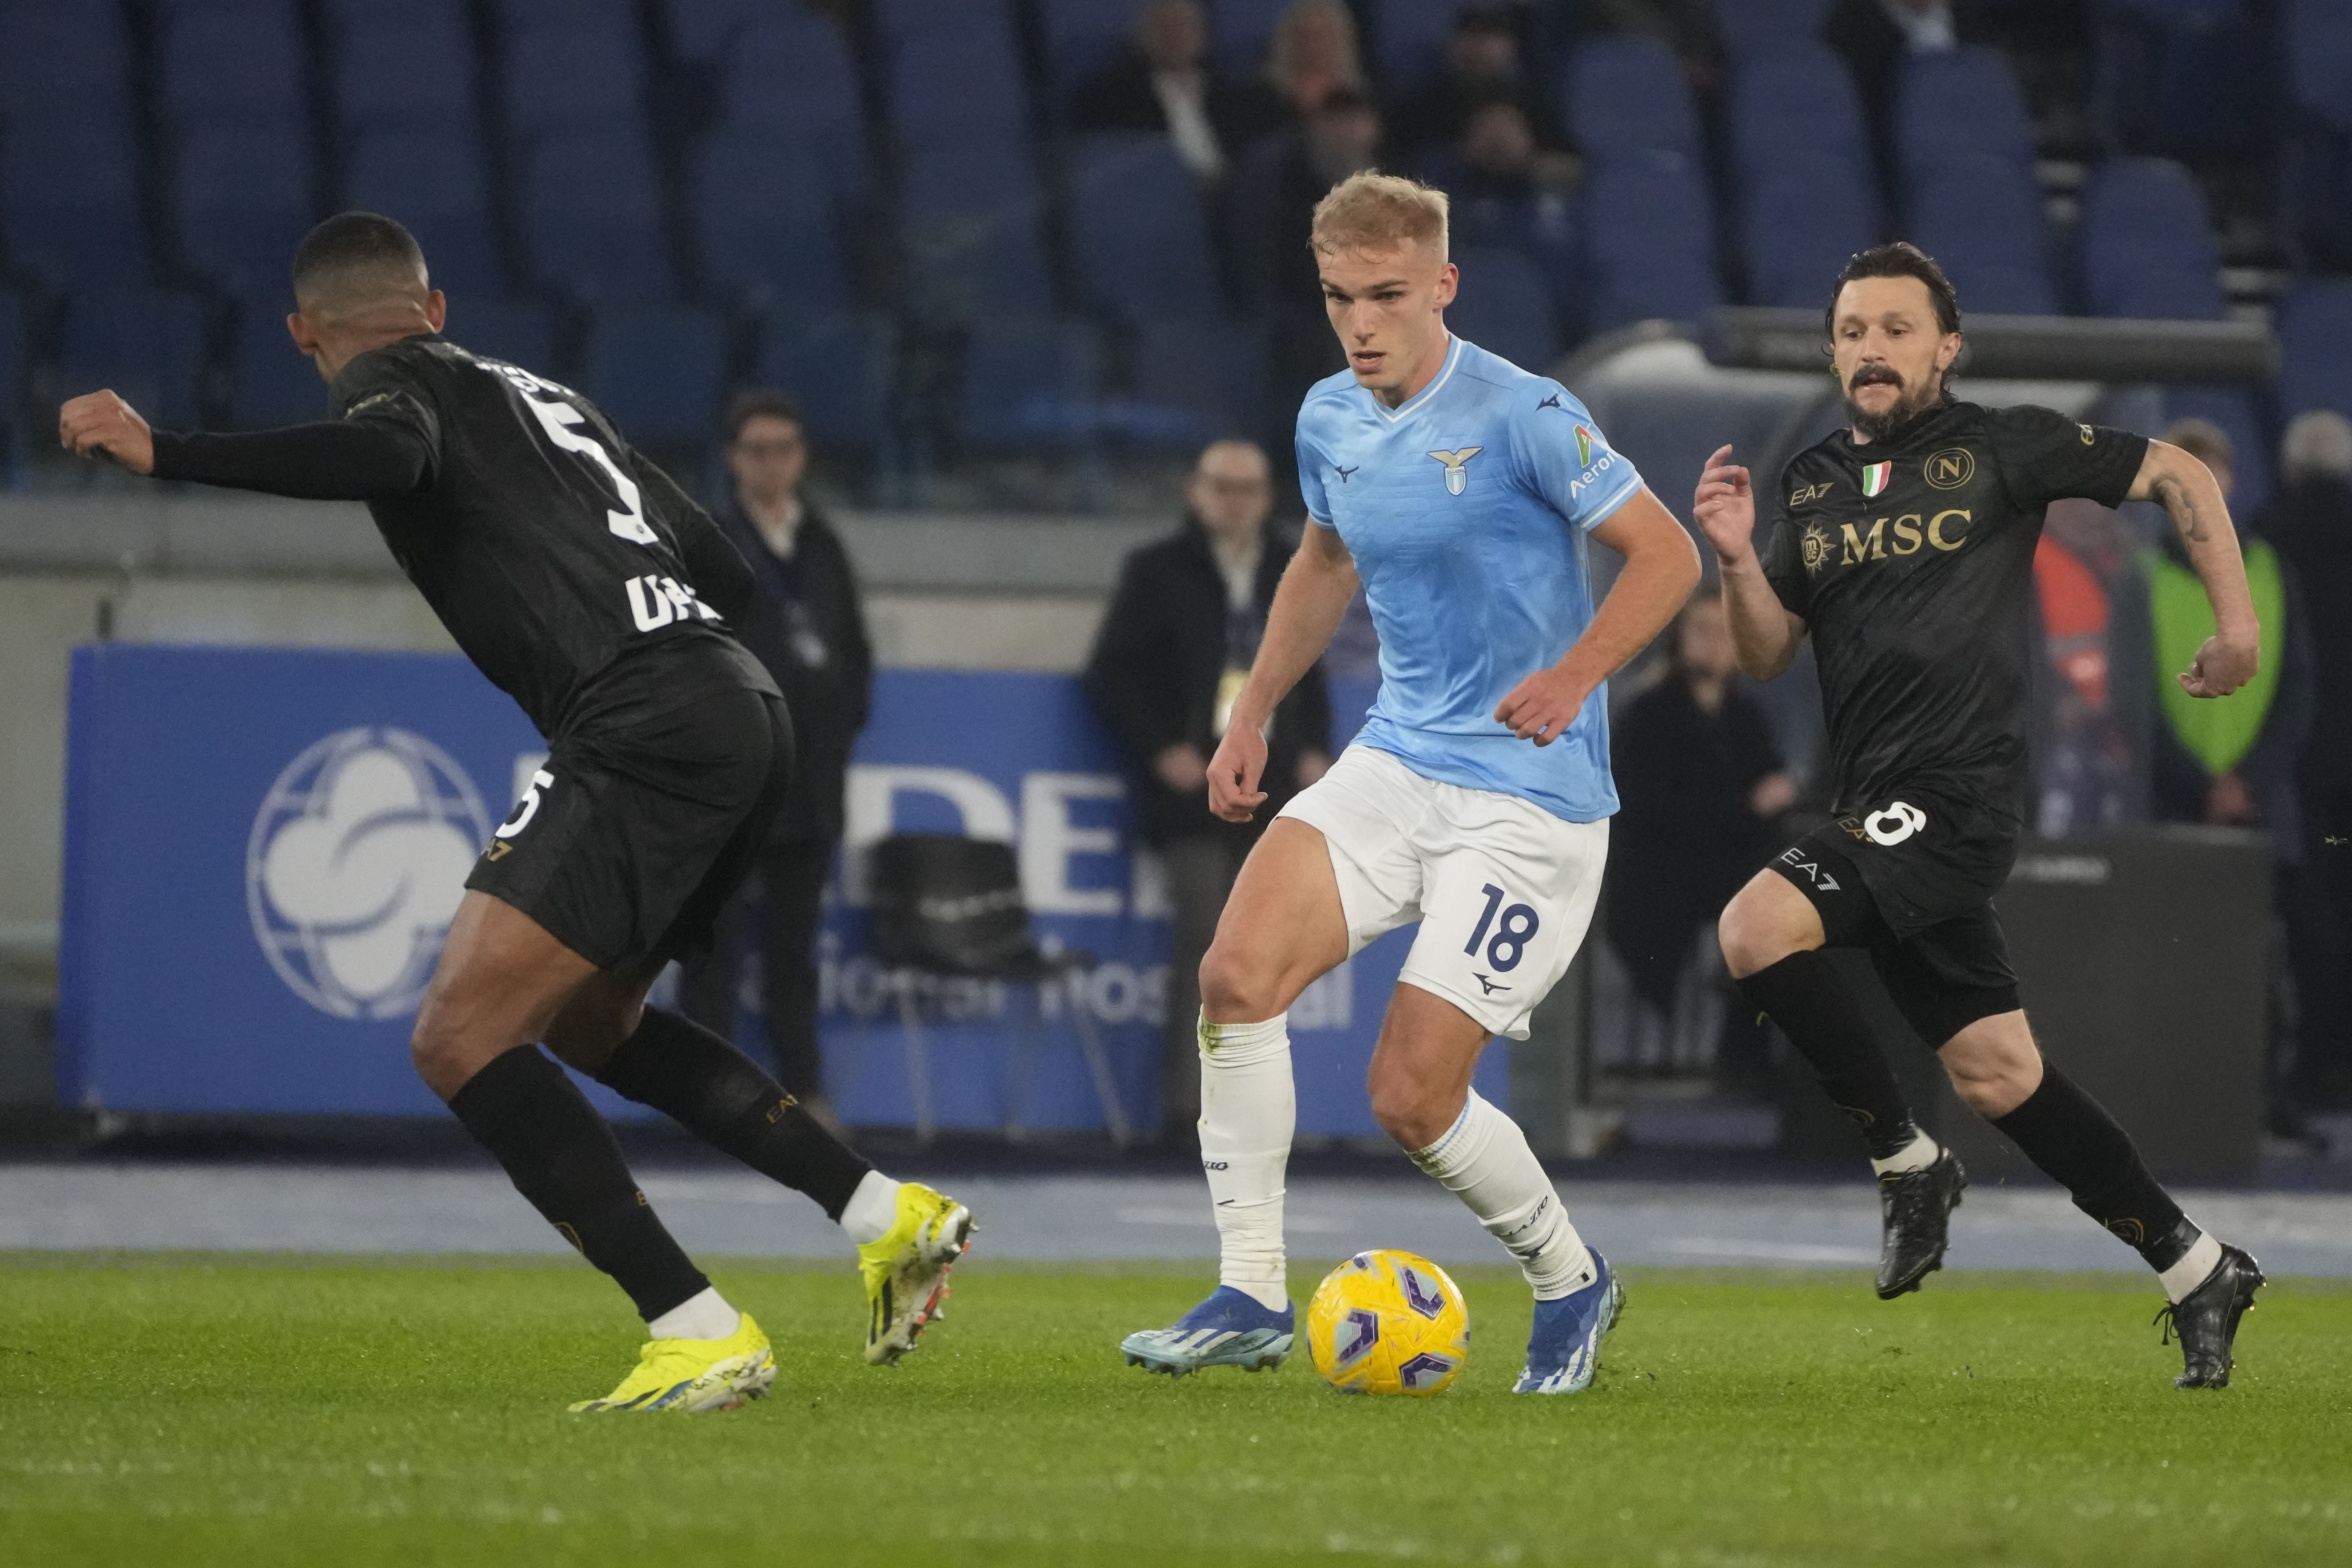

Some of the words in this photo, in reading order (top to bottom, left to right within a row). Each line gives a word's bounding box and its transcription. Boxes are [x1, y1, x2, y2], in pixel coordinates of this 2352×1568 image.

[519, 389, 659, 545] 5
[1937, 457, 1962, 479] N
[1790, 482, 1834, 506] EA7
[1840, 510, 1971, 565] MSC
[495, 769, 554, 838] 5
[1864, 801, 1926, 846] 6
[1781, 847, 1840, 891] EA7
[1464, 883, 1539, 972] 18
